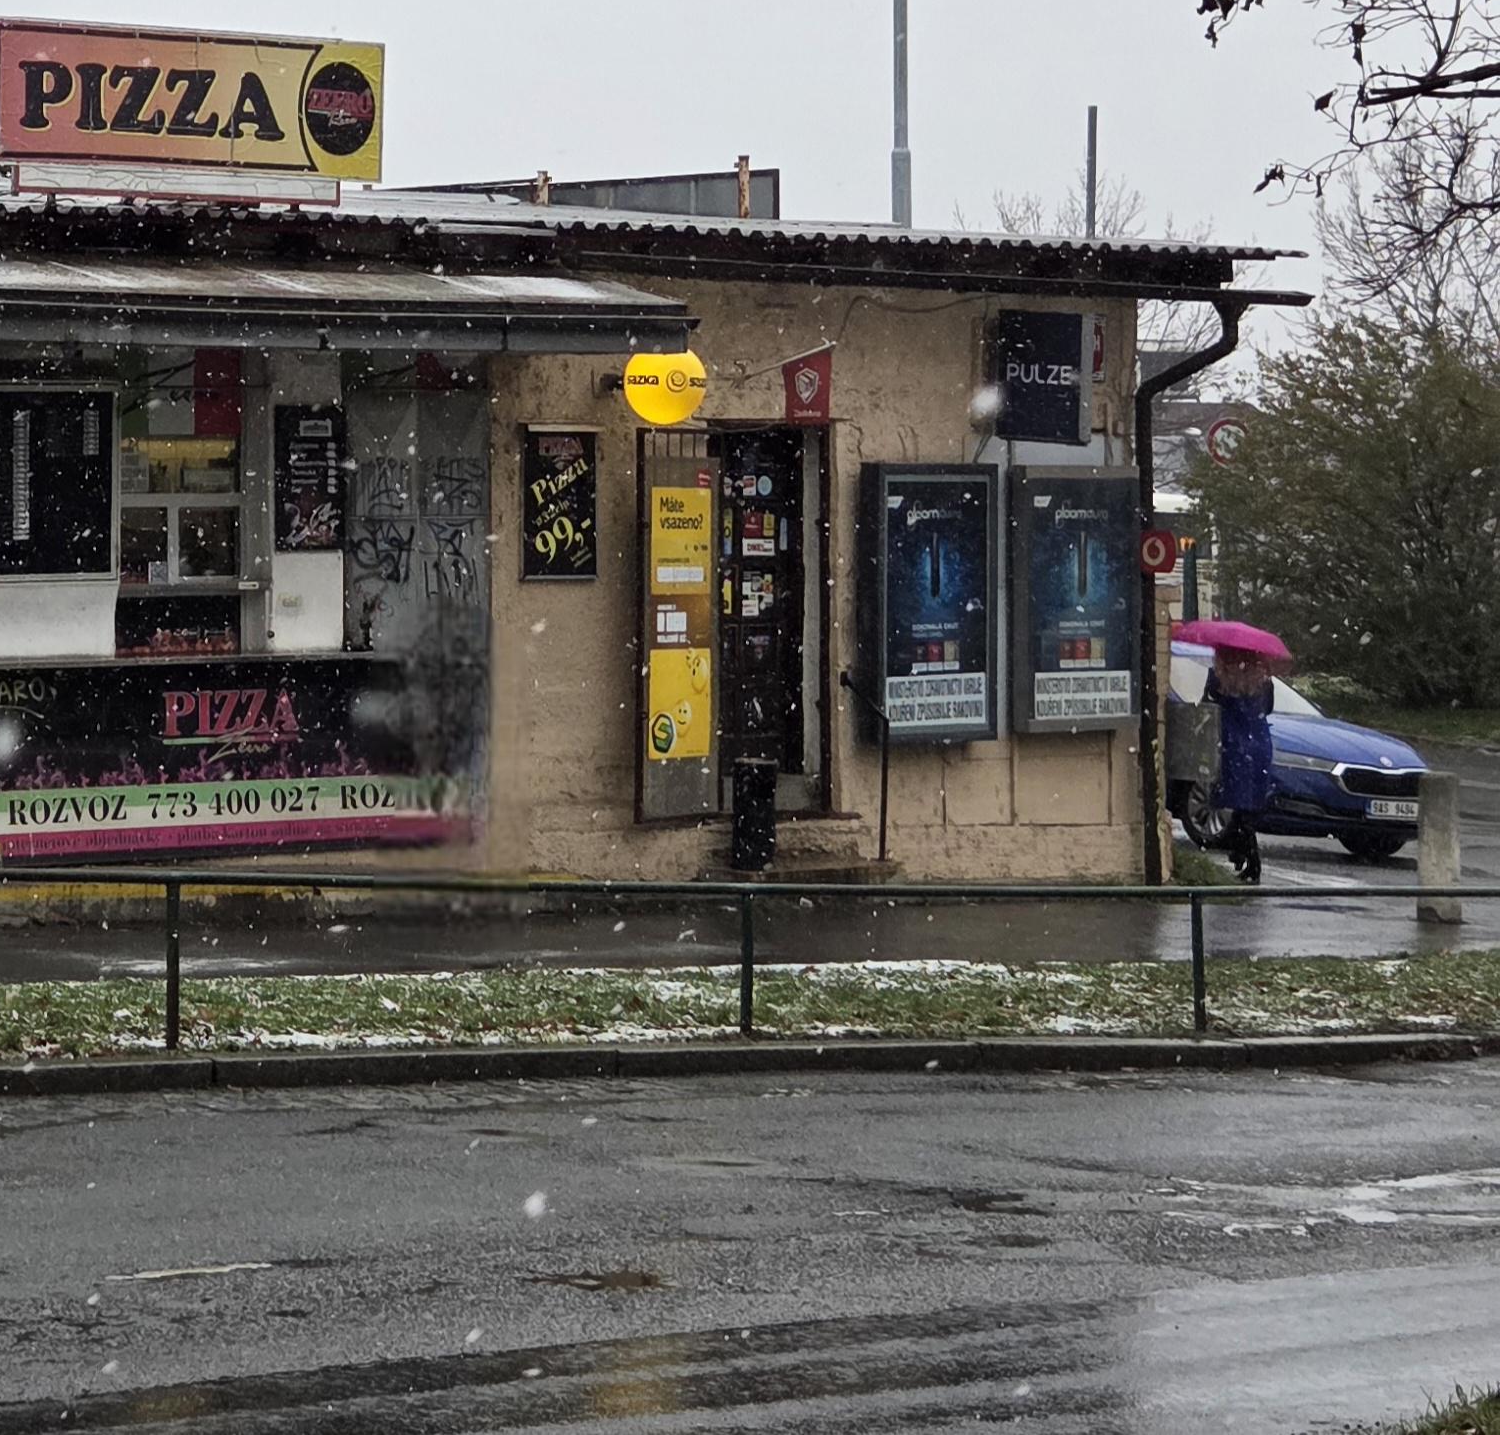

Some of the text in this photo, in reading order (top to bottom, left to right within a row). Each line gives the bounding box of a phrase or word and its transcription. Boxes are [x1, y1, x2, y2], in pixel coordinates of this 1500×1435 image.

[19, 60, 285, 142] PIZZA
[1006, 363, 1073, 385] PULZE
[529, 458, 589, 507] Pizza
[660, 496, 685, 513] Máte
[660, 513, 703, 530] vsazeno?
[162, 688, 299, 736] PIZZA
[9, 795, 127, 826] ROZVOZ
[147, 791, 198, 819] 773
[208, 788, 260, 815] 400
[270, 786, 320, 813] 027
